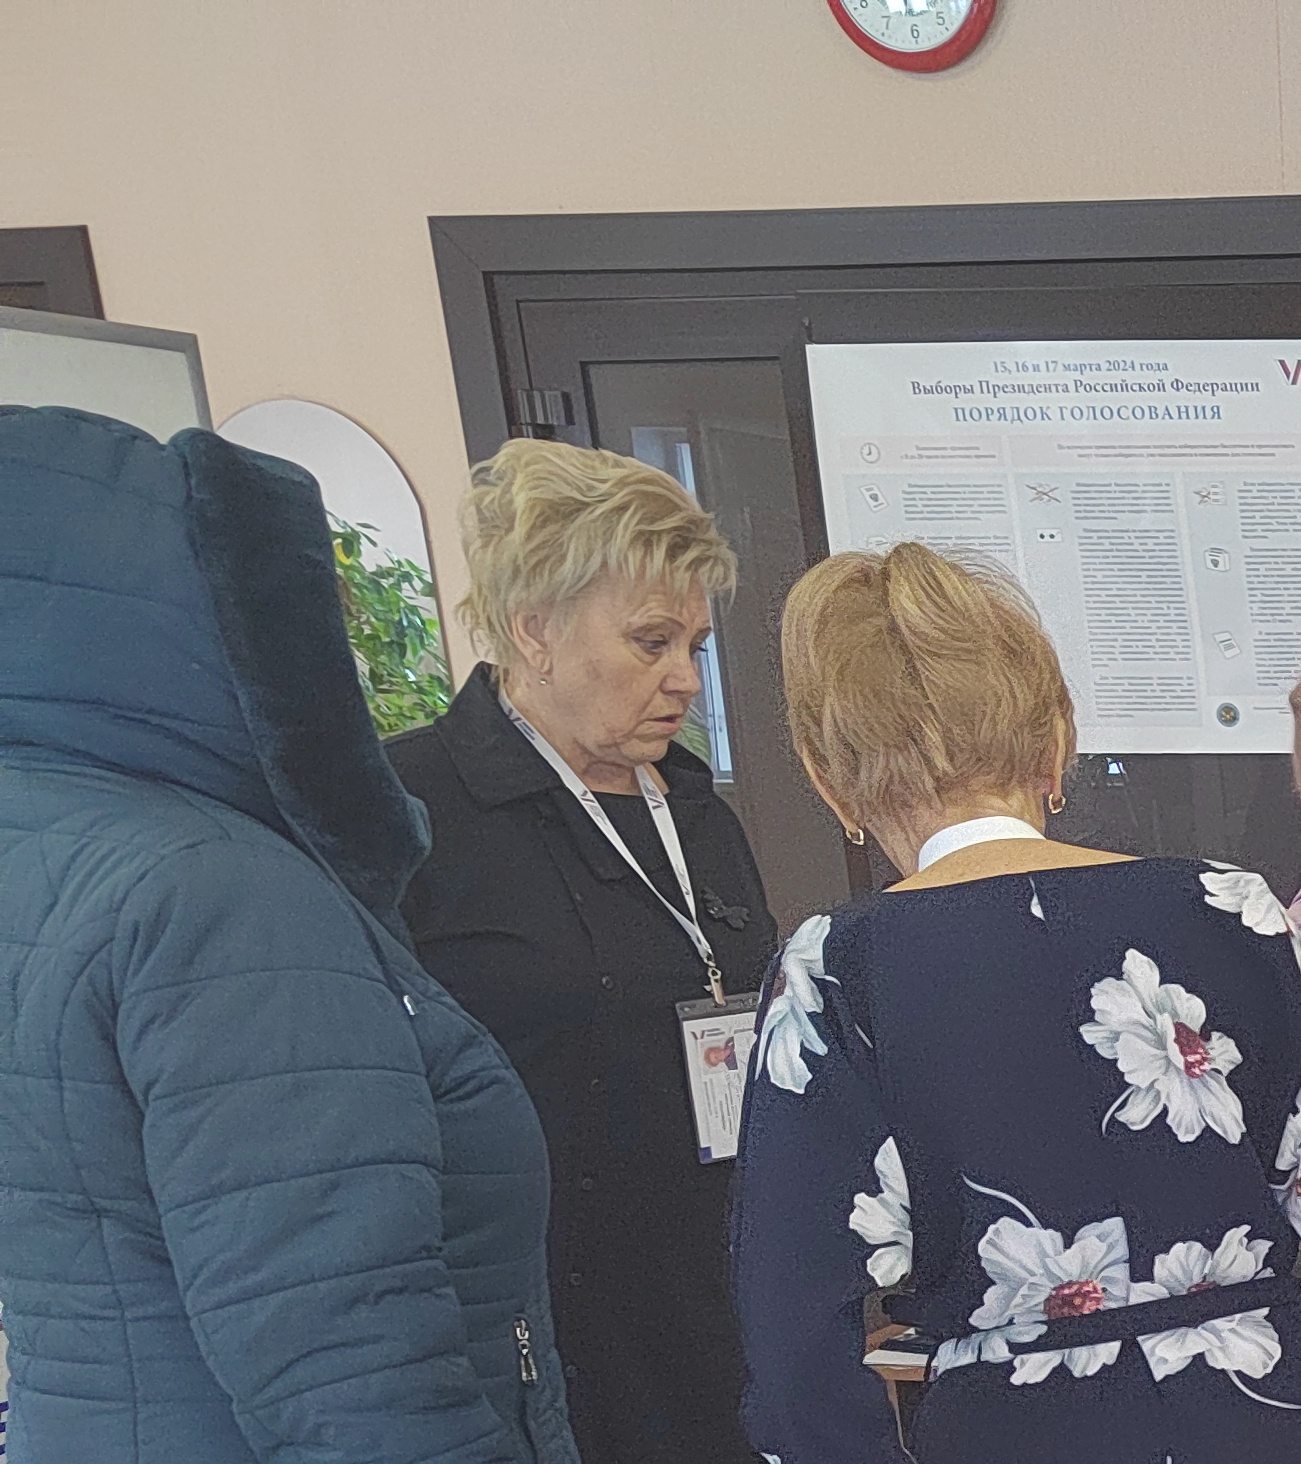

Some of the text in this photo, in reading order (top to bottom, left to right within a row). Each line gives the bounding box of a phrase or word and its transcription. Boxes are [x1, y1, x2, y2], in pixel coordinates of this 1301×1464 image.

[881, 15, 891, 30] 7
[935, 11, 945, 26] 5
[910, 23, 920, 39] 6
[993, 360, 1169, 375] 15, 16 и 17 марта 2024 года
[910, 378, 1261, 399] Выборы Президента Российской Федерации
[953, 404, 1223, 424] ПОРЯДОК ГОЛОСОВАНИЯ
